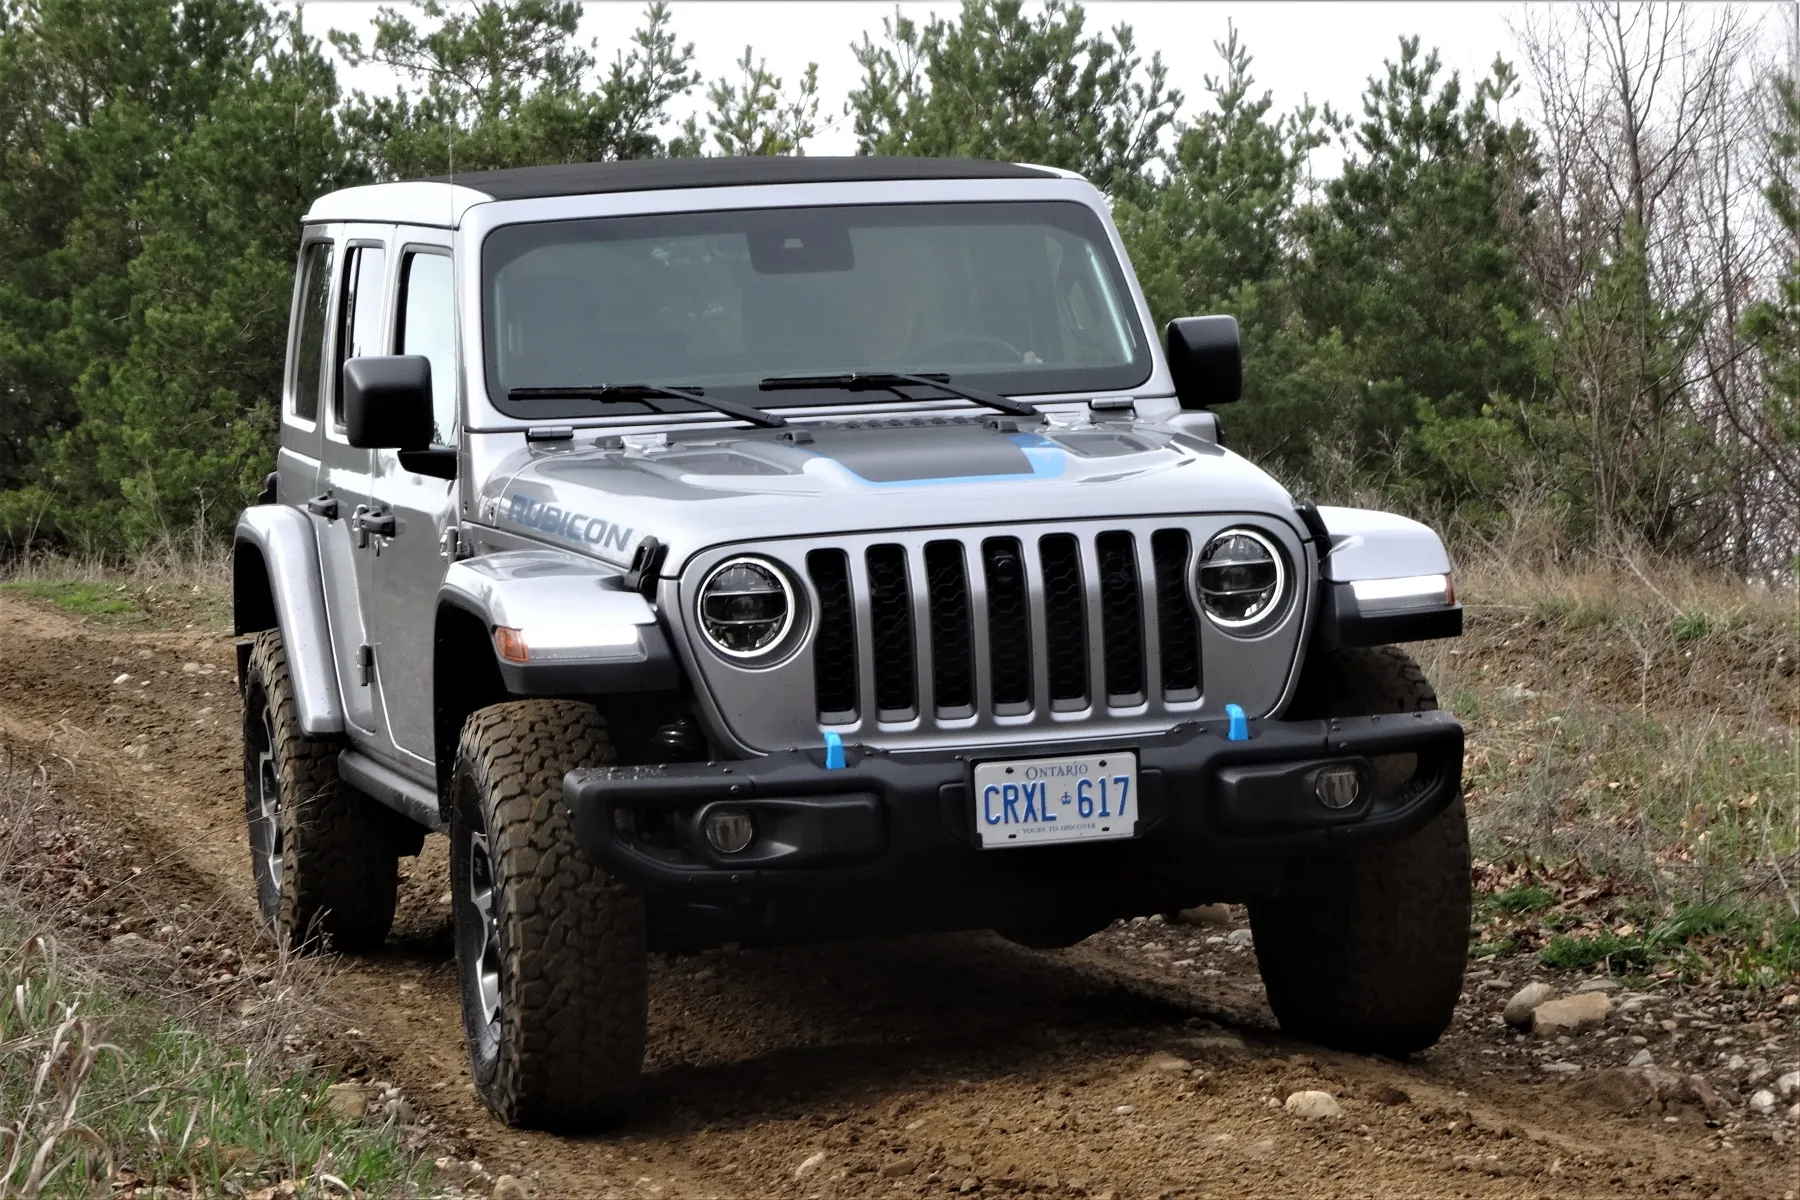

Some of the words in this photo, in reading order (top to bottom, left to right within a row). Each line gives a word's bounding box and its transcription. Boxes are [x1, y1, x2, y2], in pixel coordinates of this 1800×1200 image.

[507, 494, 634, 552] RUBICON
[1026, 764, 1088, 780] ONTARIO
[983, 781, 1057, 825] CRXL
[1076, 775, 1130, 818] 617
[1022, 826, 1046, 834] YOURS
[1060, 822, 1096, 832] DISCOVER
